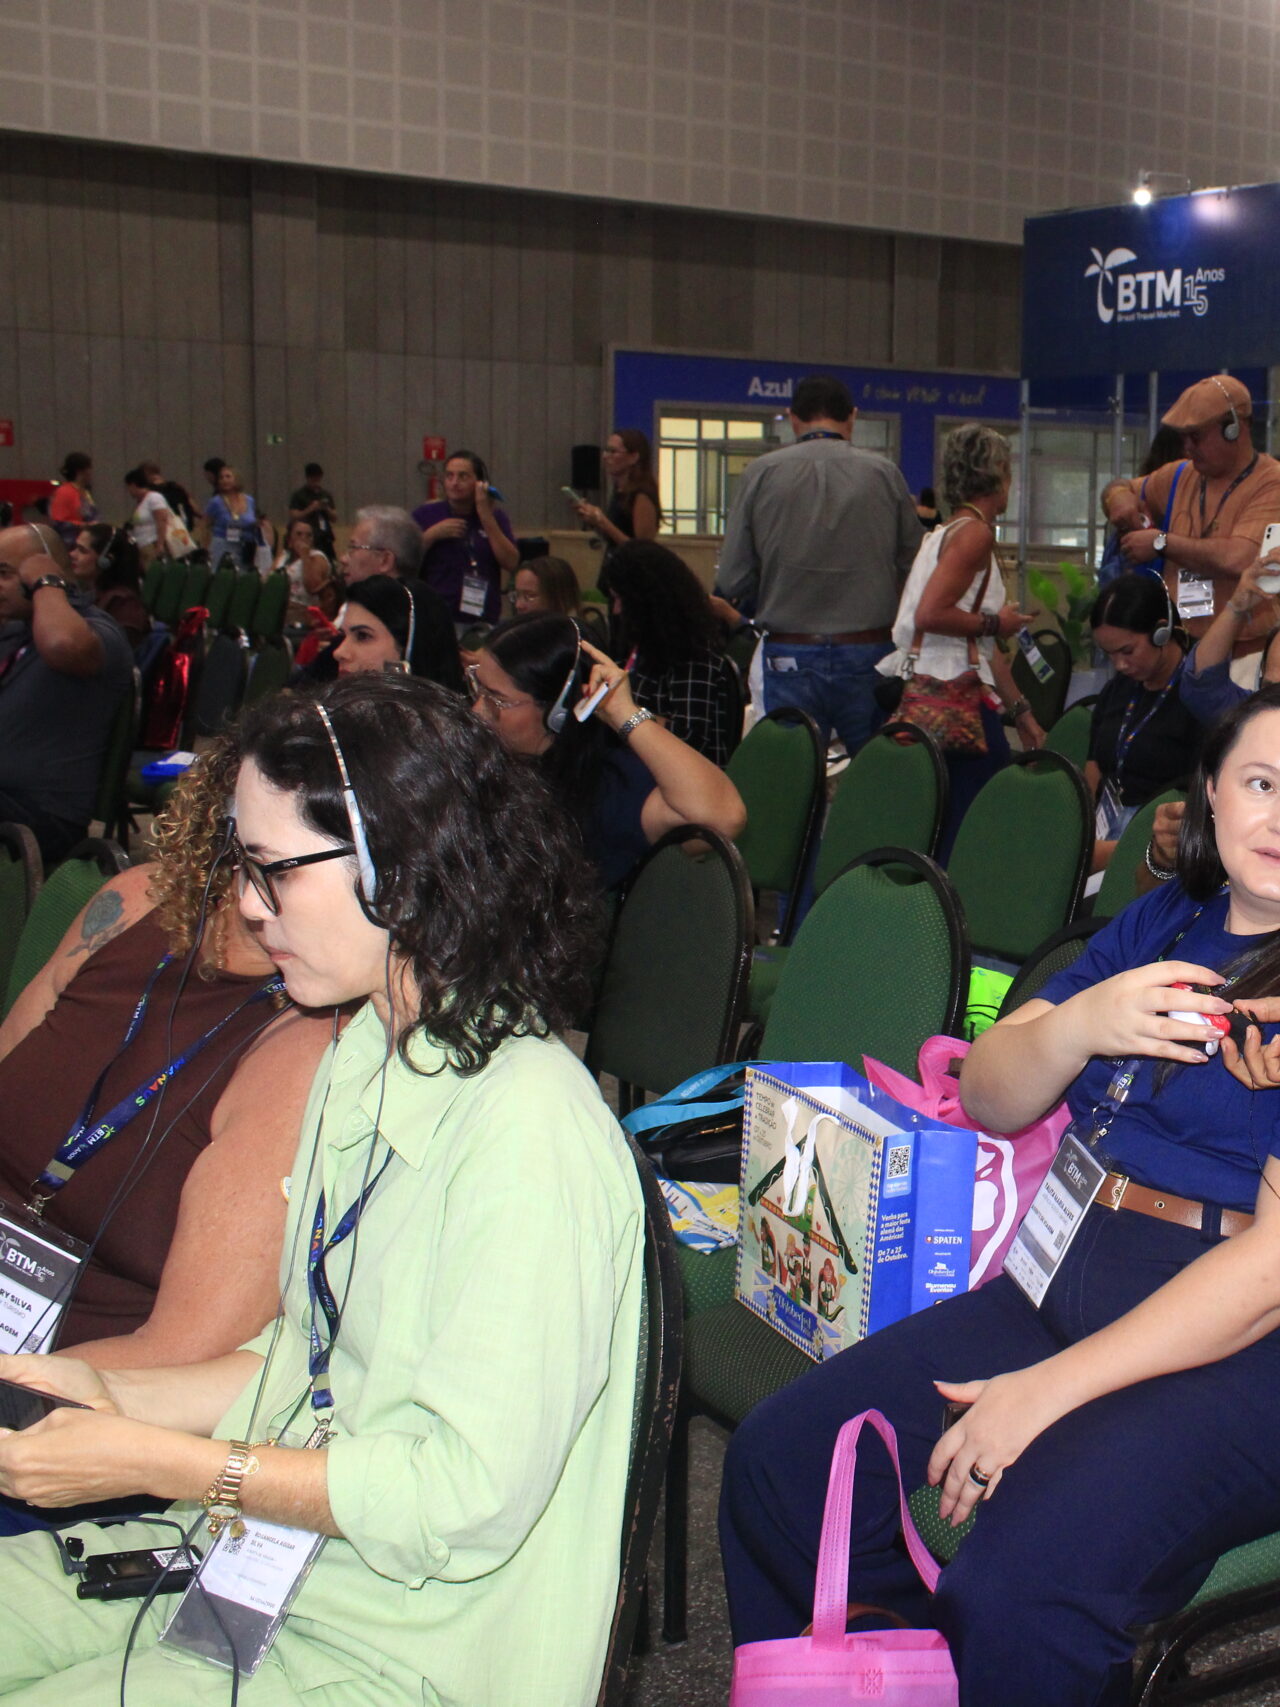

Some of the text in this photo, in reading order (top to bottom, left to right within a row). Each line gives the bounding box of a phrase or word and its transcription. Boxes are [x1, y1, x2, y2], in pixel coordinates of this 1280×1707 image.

[1195, 267, 1225, 282] Anos
[1117, 268, 1182, 312] BTM
[1183, 275, 1208, 316] 15
[1117, 310, 1180, 322] Brazil Travel Market
[748, 376, 792, 397] Azul
[135, 1057, 187, 1107] MANAUS
[66, 1127, 105, 1161] BTM Anos
[1067, 1163, 1080, 1182] BTM
[882, 1213, 896, 1221] Venha
[933, 1236, 962, 1244] SPATEN
[7, 1248, 37, 1274] BTM
[9, 1293, 32, 1312] SILVA
